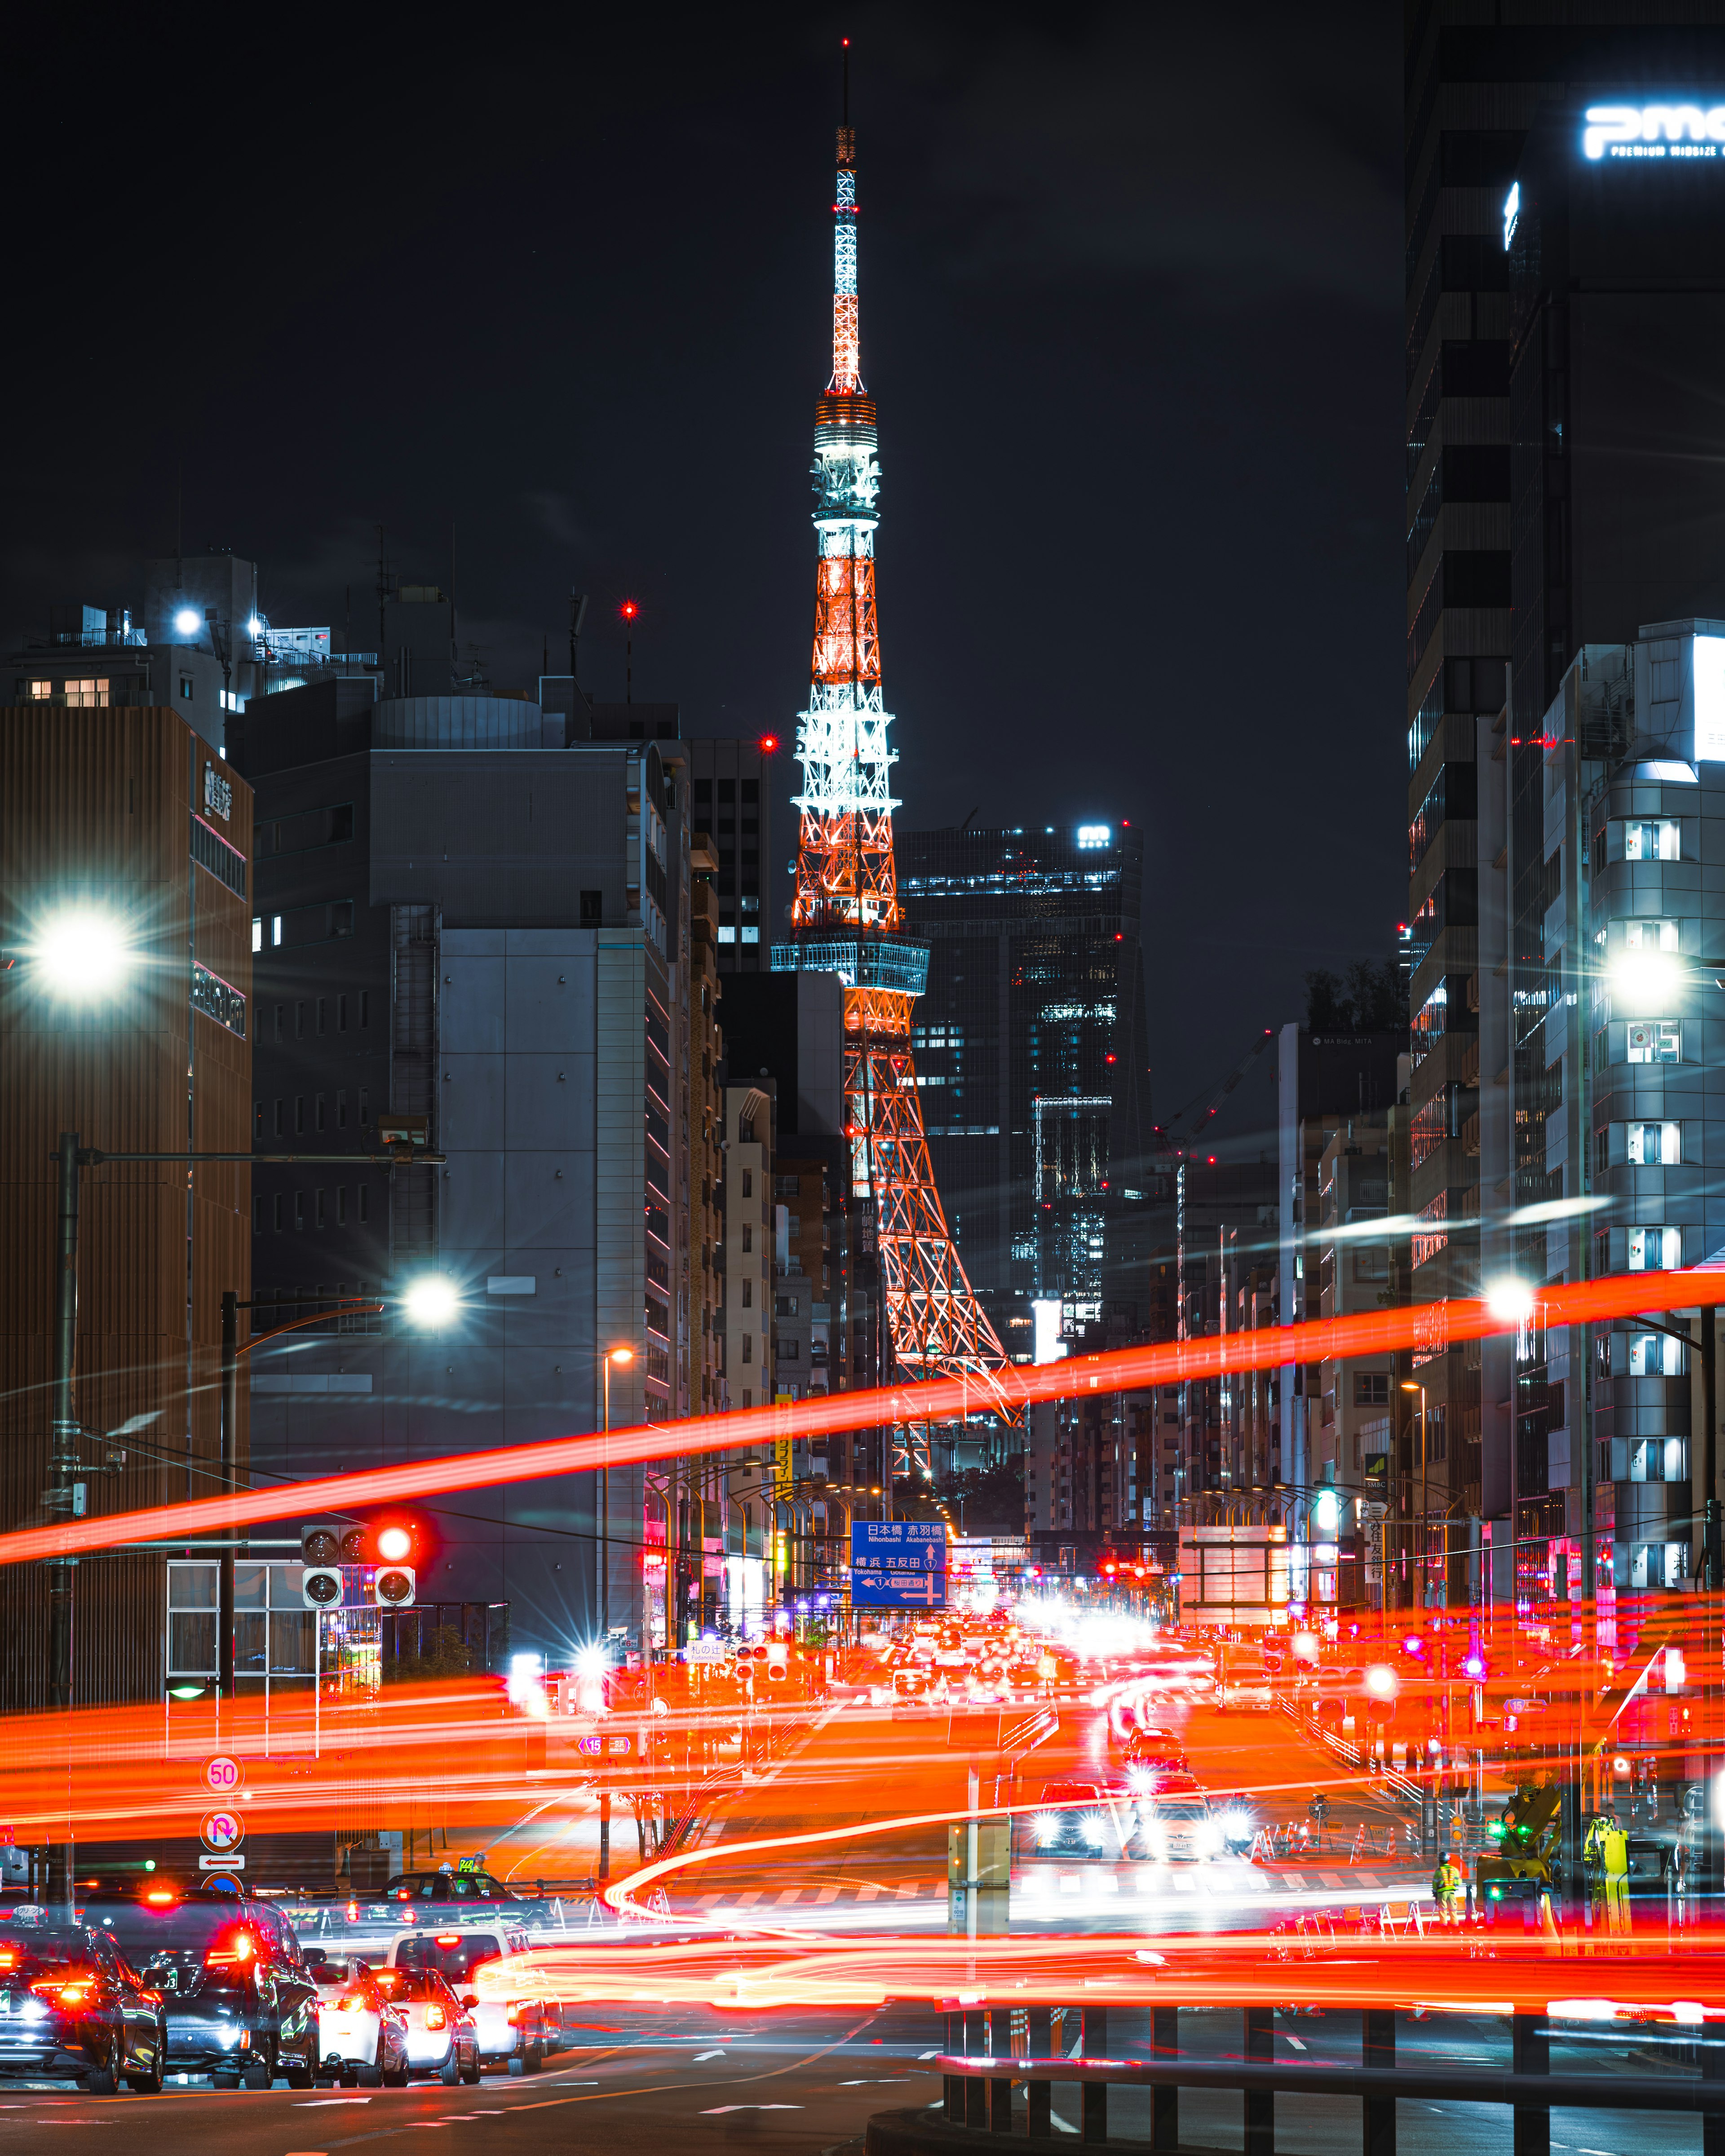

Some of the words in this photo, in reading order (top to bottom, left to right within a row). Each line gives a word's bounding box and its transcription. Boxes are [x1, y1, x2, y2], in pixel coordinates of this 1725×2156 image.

[1611, 146, 1666, 157] PREMIUM
[1670, 146, 1717, 157] MIDSIZE
[862, 1202, 874, 1252] 川崎地質
[868, 1524, 902, 1536] 日本橋
[907, 1525, 942, 1536] 赤羽橋
[855, 1557, 881, 1568] 横浜
[885, 1557, 920, 1568] 五反田
[691, 1645, 721, 1654] 札の辻
[1512, 1701, 1522, 1710] 15
[589, 1740, 601, 1751] 15
[609, 1740, 624, 1748] 一京浜
[211, 1764, 235, 1784] 50
